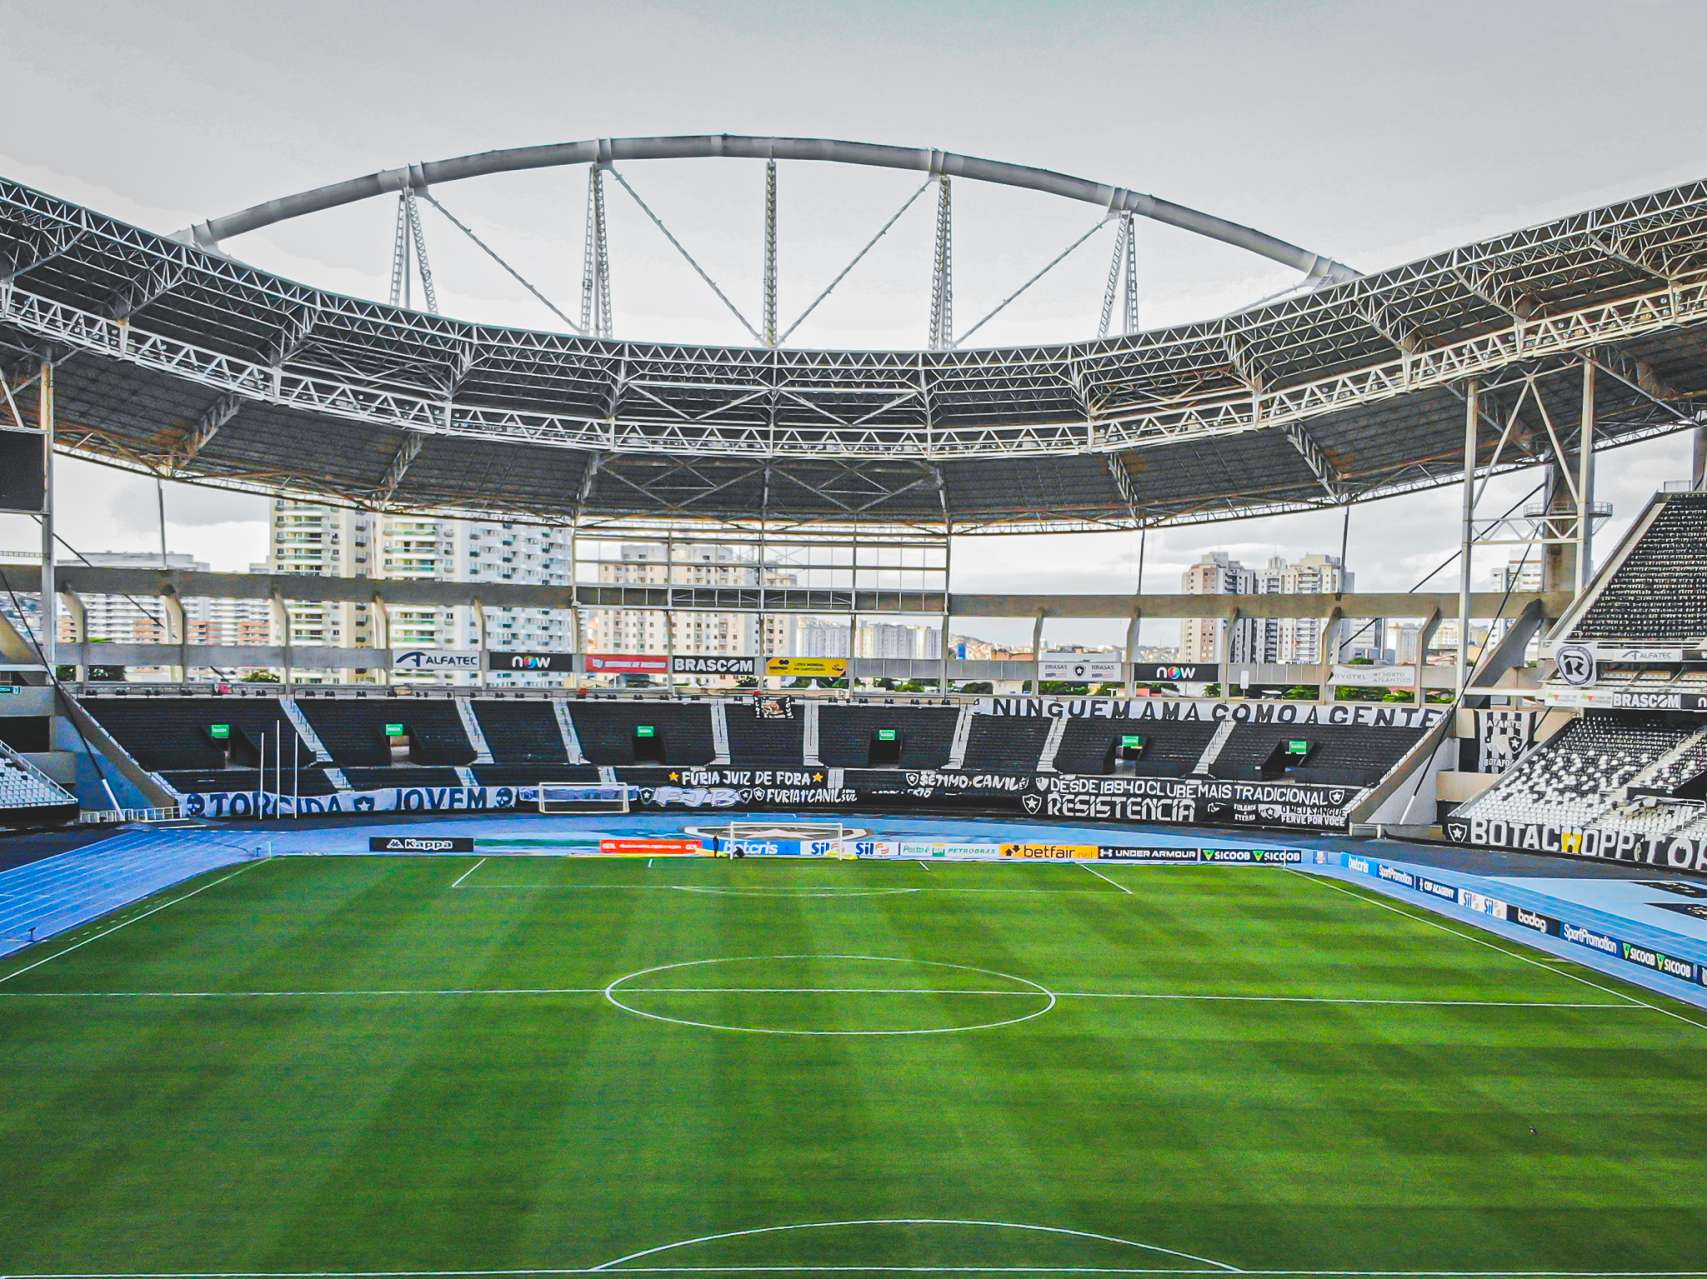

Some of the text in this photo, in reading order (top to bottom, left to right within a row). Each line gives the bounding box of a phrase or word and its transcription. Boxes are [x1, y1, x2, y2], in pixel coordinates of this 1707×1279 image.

[425, 656, 478, 666] ALFATEC
[511, 655, 550, 669] now
[674, 658, 753, 674] BRASCOM
[1156, 666, 1196, 680] now
[1613, 693, 1680, 708] BRASCOM
[993, 698, 1443, 729] NINGUEM AMA COMO A GENTE
[754, 771, 773, 786] DE
[776, 771, 810, 786] FORA
[1050, 777, 1099, 794] DESDE
[1146, 782, 1196, 798] CLUBE
[1198, 784, 1232, 799] MAIS
[1234, 785, 1328, 806] TRADICIONAL
[394, 787, 488, 812] JOVEM
[1047, 793, 1196, 823] RESISTENCIA
[1281, 814, 1307, 825] FERVE
[404, 838, 453, 850] Kappa
[1024, 845, 1075, 858] betfair
[1116, 849, 1196, 858] UNDER ARMOUR
[1214, 851, 1250, 861] SICOOB
[1264, 852, 1300, 862] SICOOB
[1518, 907, 1547, 933] bodog
[1564, 924, 1617, 953] SportPromotion
[1630, 947, 1656, 966] SICOOB
[1664, 958, 1691, 978] SICOOB
